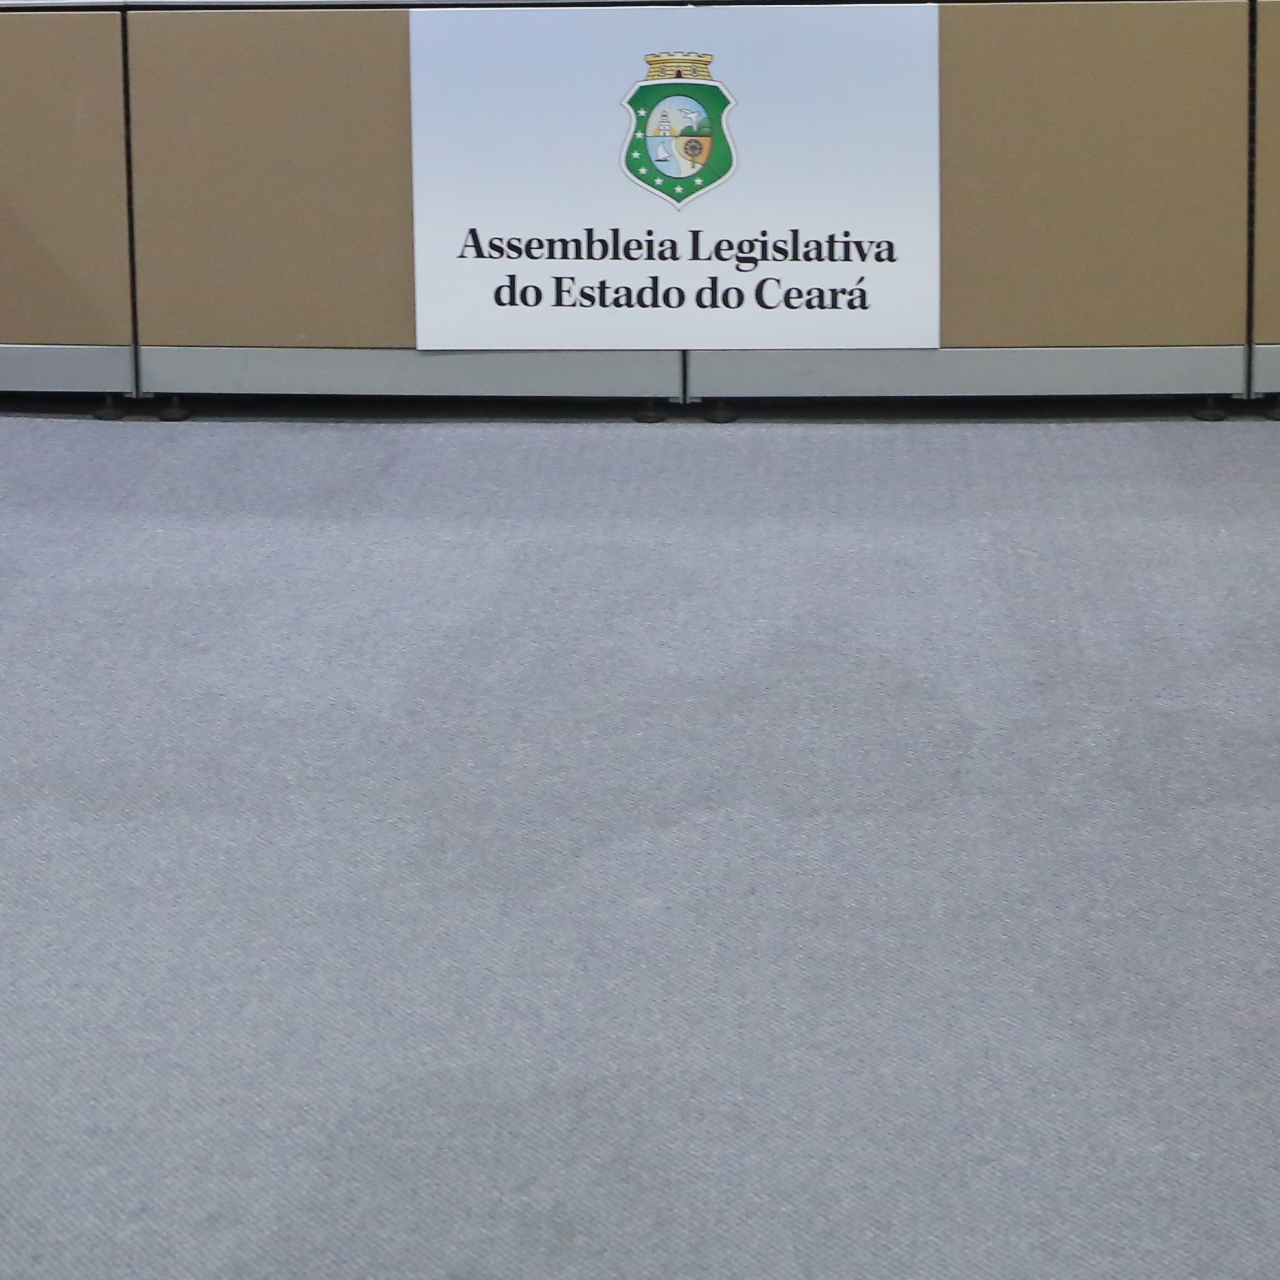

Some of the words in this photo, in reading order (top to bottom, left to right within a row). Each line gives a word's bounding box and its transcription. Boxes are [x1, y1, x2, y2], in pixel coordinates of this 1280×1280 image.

[457, 227, 680, 262] Assembleia
[687, 228, 898, 273] Legislativa
[493, 274, 543, 308] do
[551, 275, 686, 310] Estado
[695, 276, 745, 310] do
[754, 276, 870, 311] Ceará
